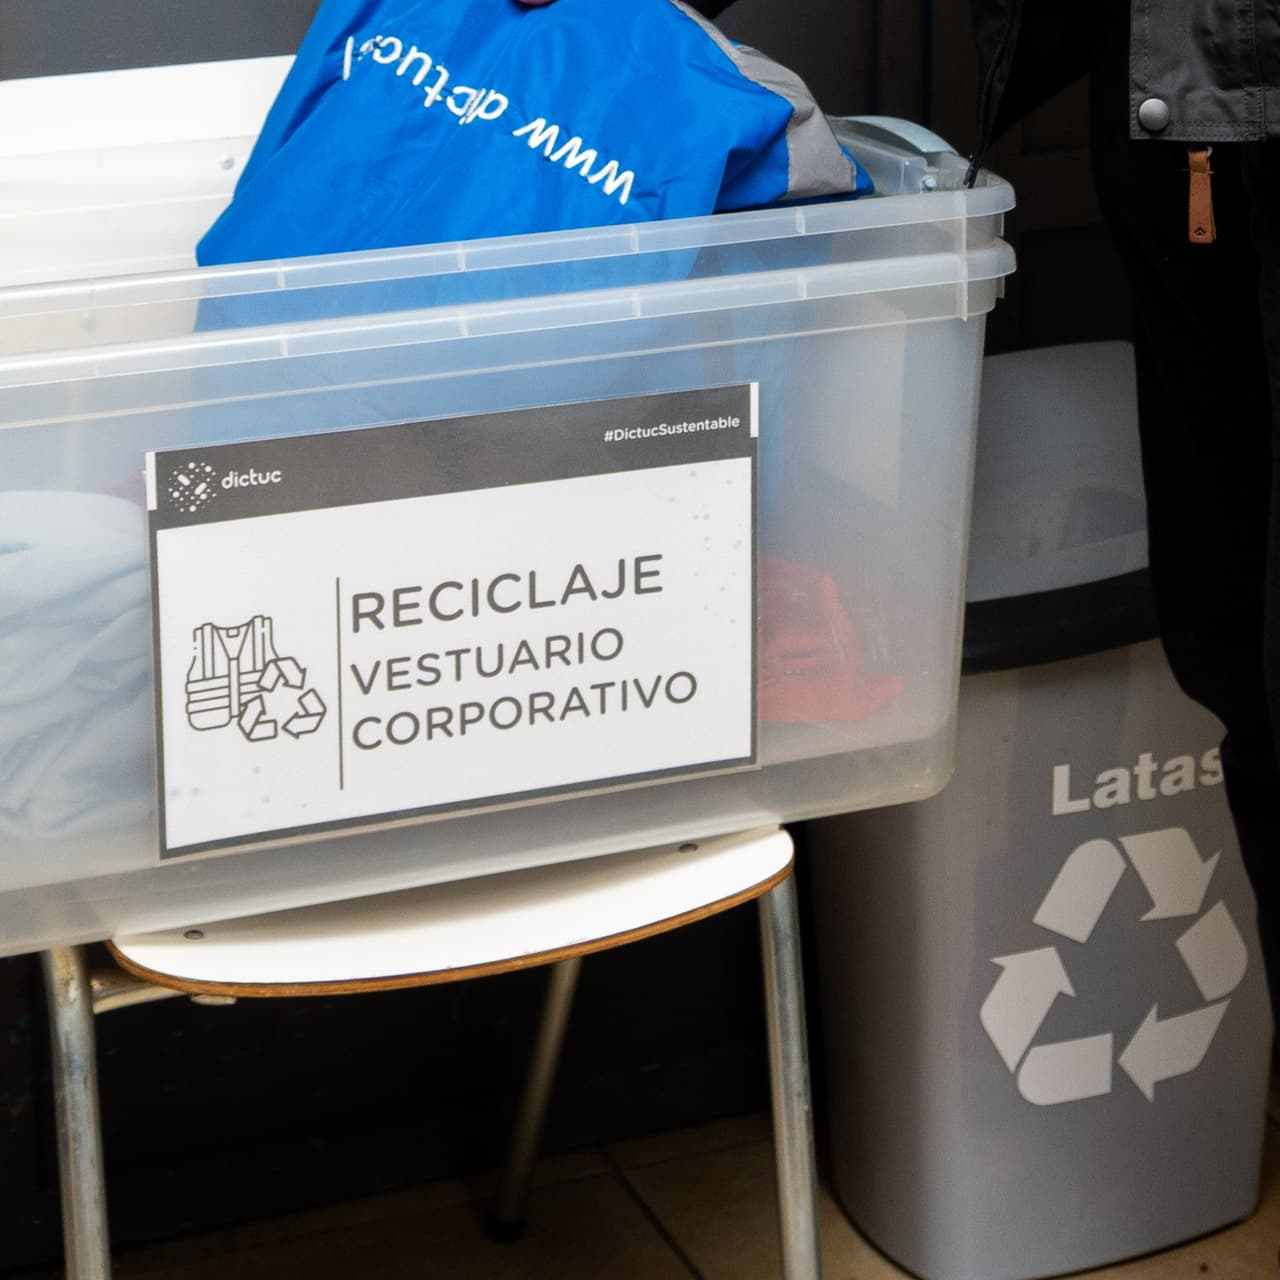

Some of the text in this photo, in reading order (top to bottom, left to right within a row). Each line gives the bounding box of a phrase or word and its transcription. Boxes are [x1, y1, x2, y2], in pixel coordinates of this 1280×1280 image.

[604, 415, 740, 444] #DictucSustentable
[221, 467, 282, 490] dictuc
[352, 553, 663, 633] RECICLAJE
[350, 627, 624, 695] VESTUARIO
[352, 671, 698, 751] CORPORATIVO
[1051, 749, 1224, 817] Latas
